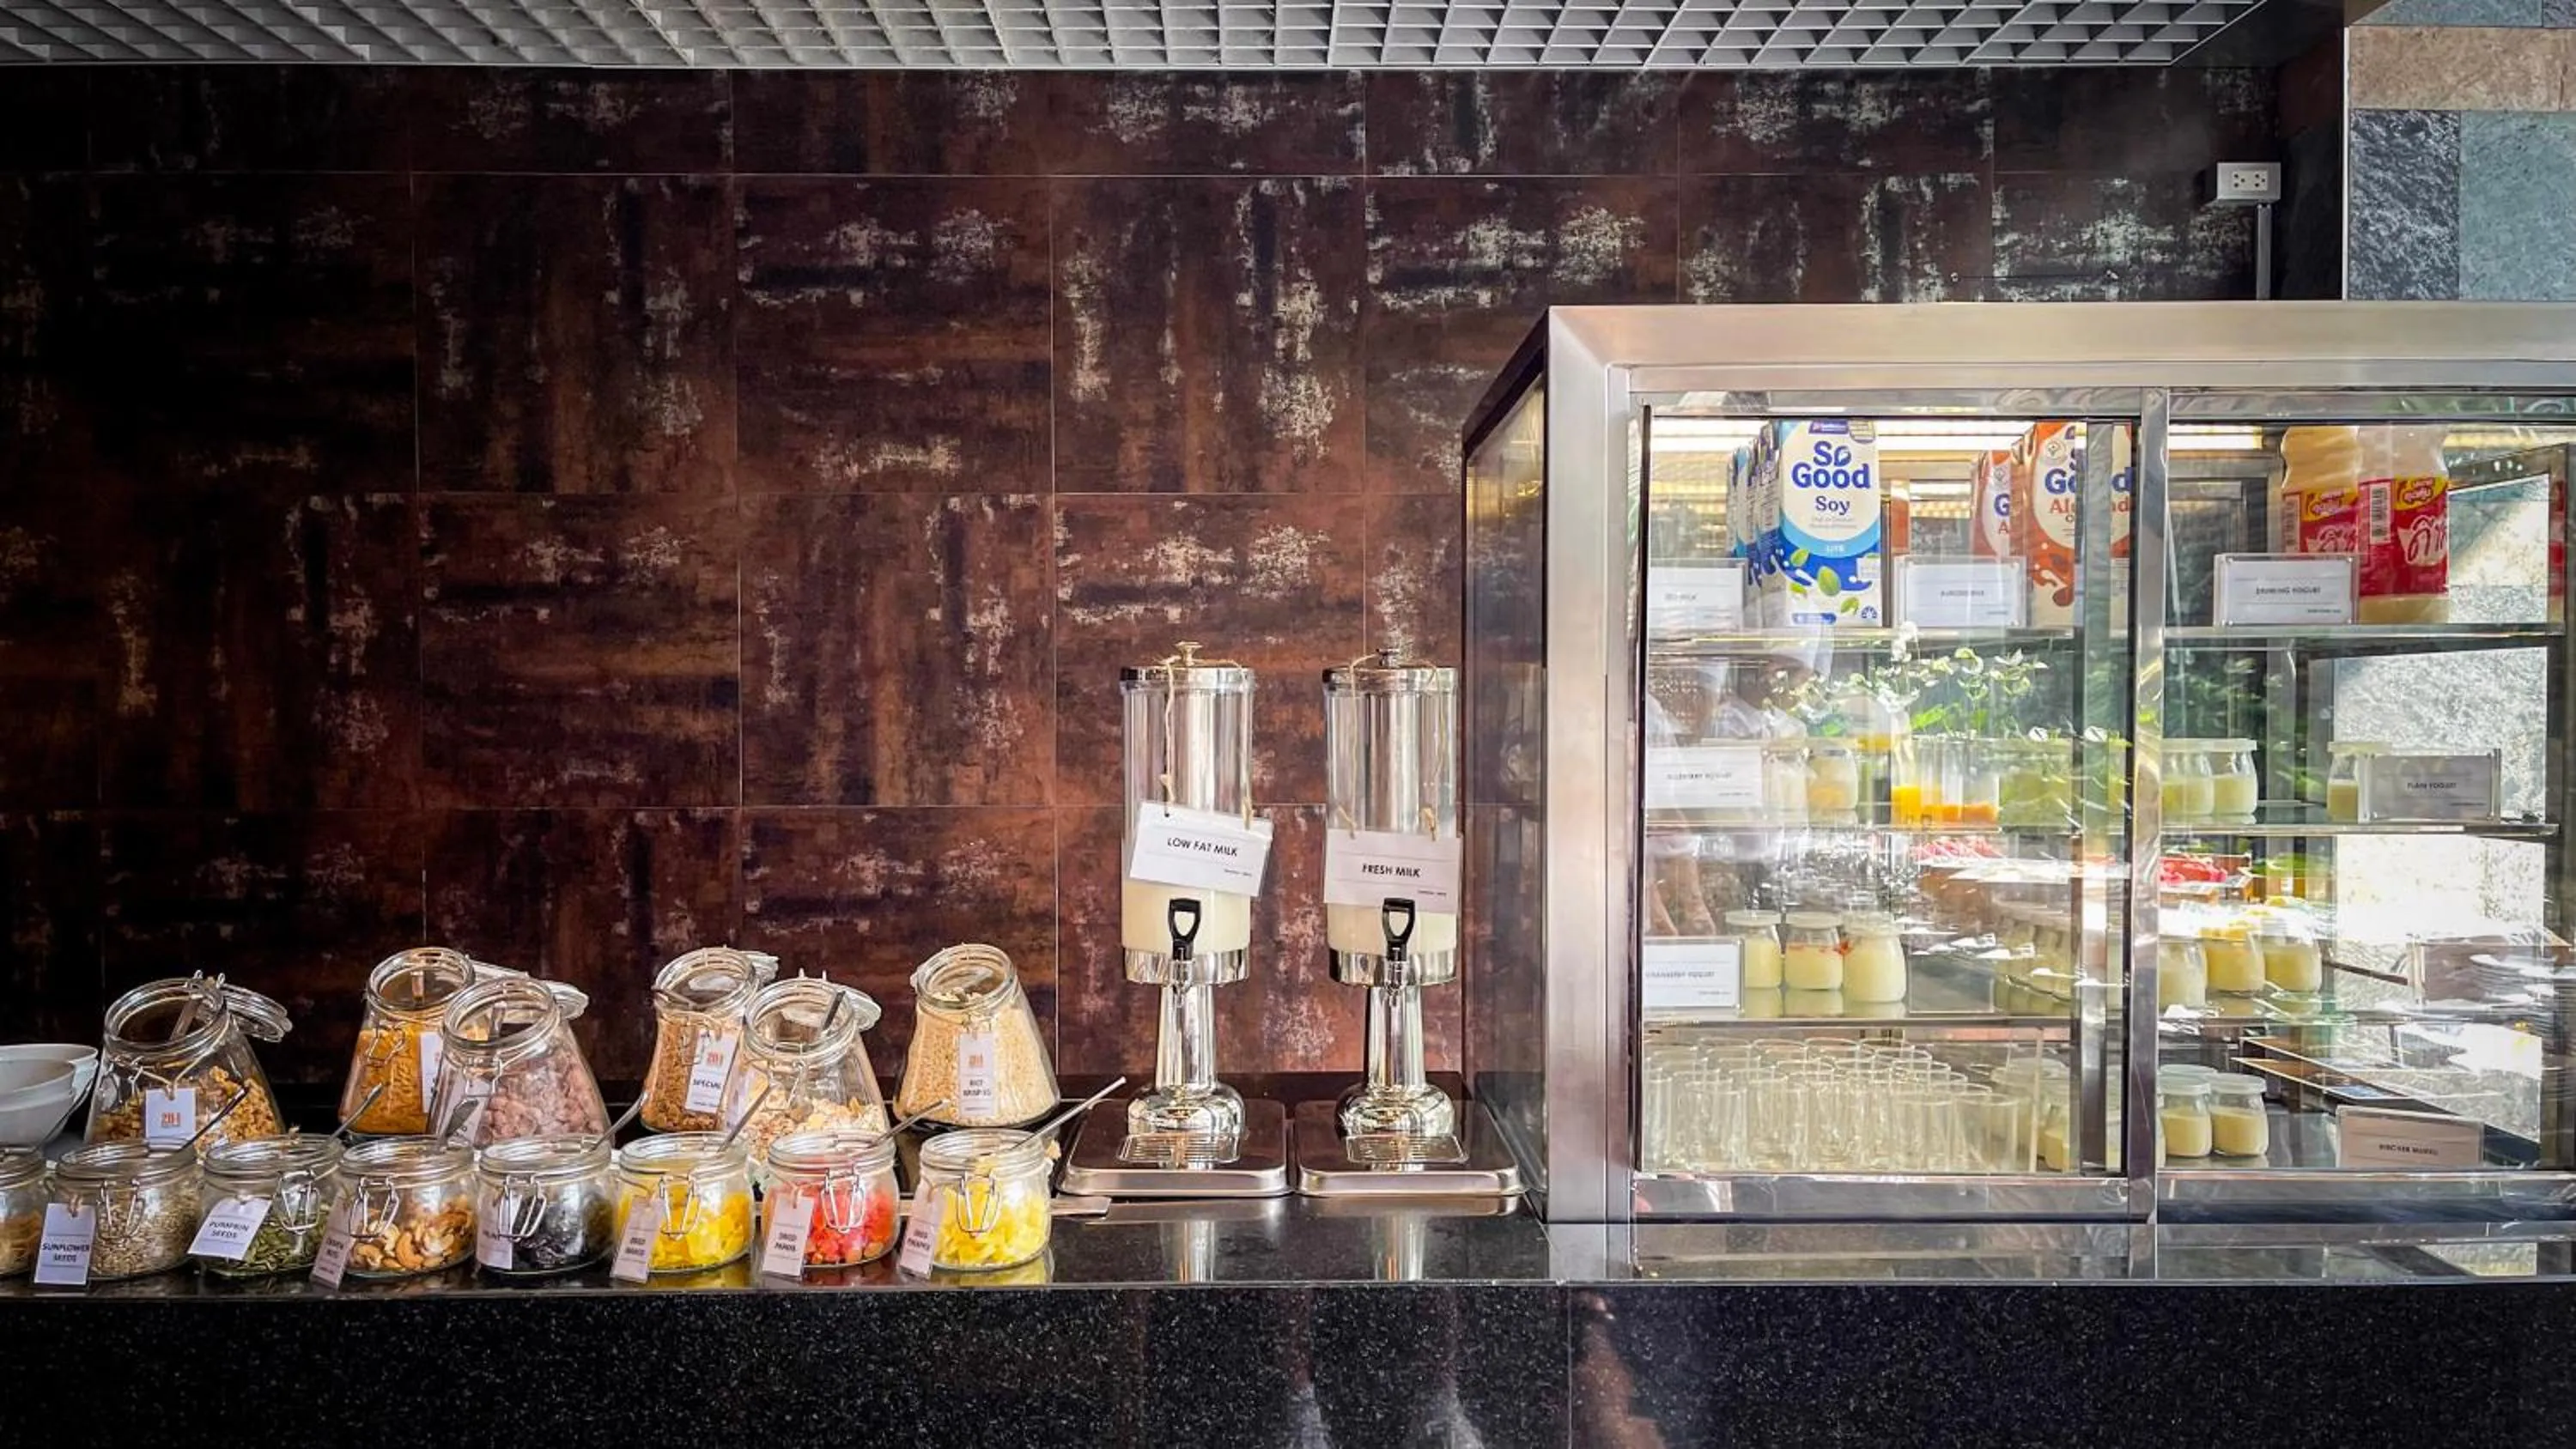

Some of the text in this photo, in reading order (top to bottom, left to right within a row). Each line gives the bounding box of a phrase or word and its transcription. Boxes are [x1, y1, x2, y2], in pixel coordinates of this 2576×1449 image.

[1814, 440, 1852, 466] So
[1791, 462, 1871, 488] Good
[1815, 495, 1850, 515] Soy
[1167, 837, 1238, 858] LOW FAT MILK
[1362, 863, 1421, 878] FRESH MILK
[209, 1221, 250, 1232] PUMPKIN
[42, 1242, 90, 1252] SUNFLOWER
